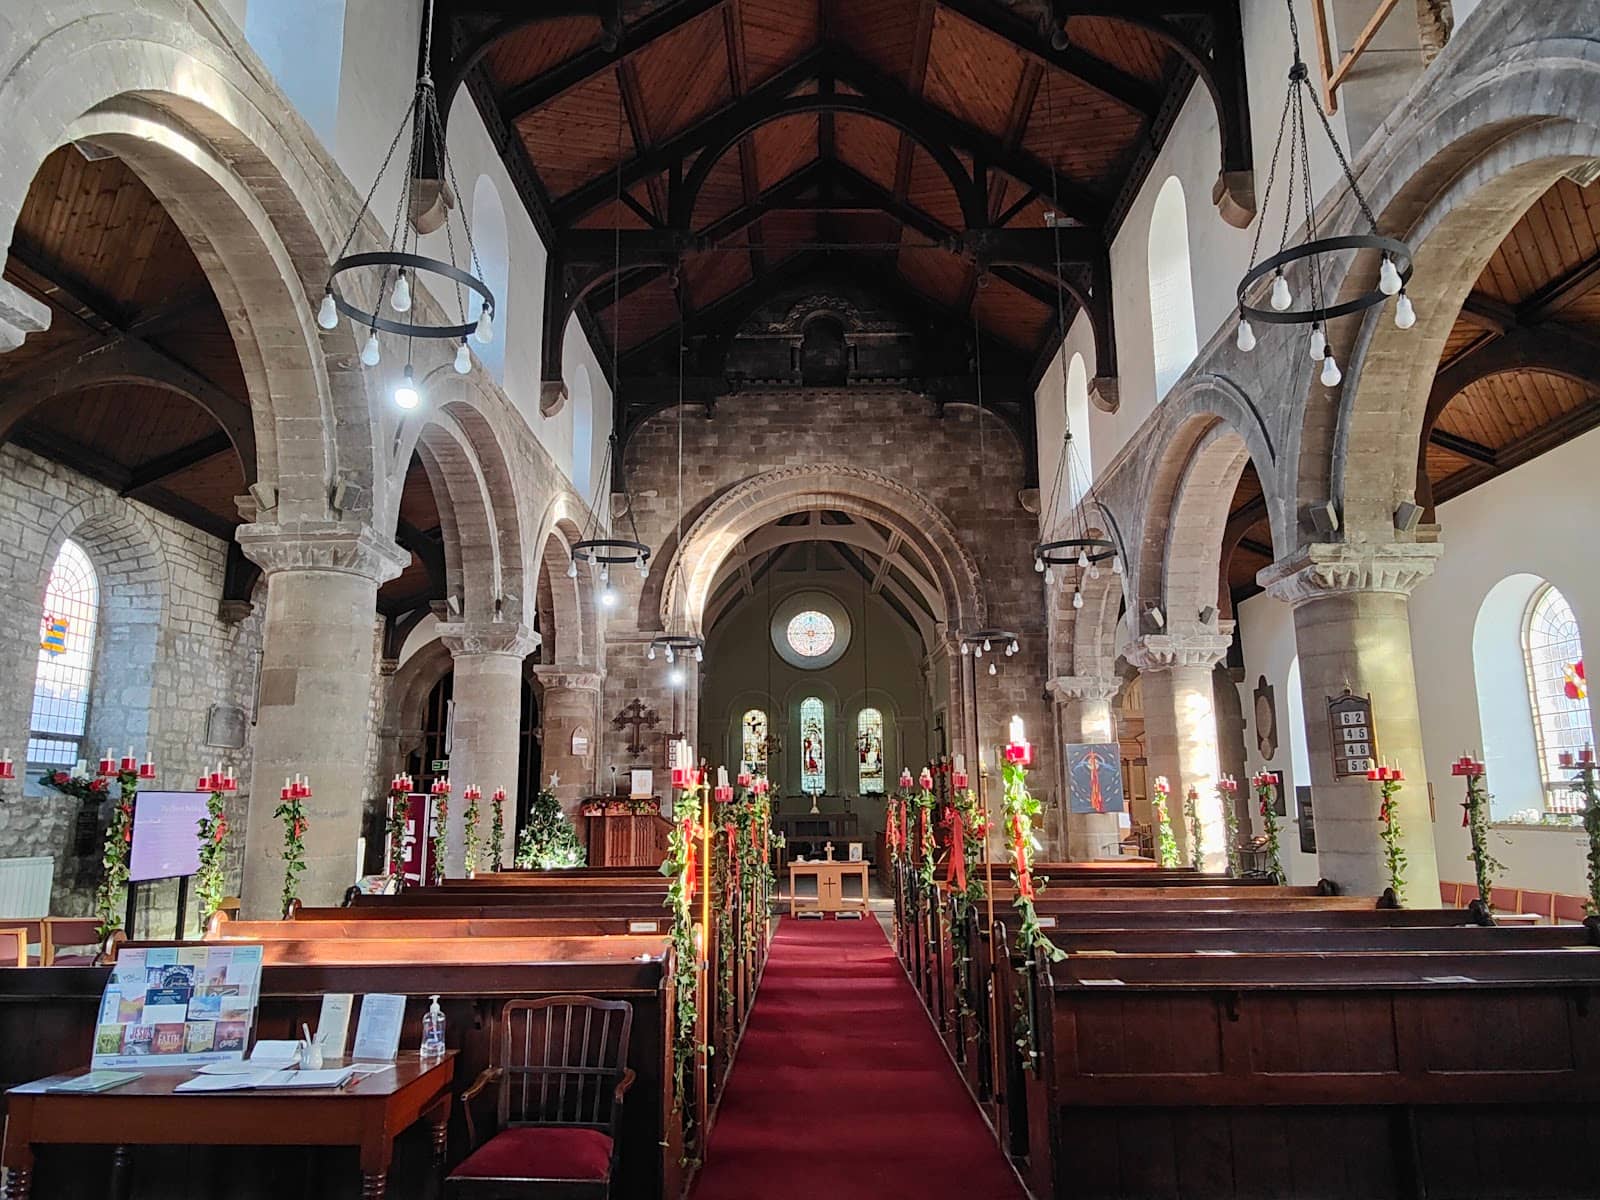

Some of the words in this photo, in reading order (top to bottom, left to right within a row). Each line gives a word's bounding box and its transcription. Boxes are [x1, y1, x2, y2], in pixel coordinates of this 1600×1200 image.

[1344, 713, 1361, 723] 62
[1347, 729, 1364, 739] 45
[1348, 745, 1366, 754] 48
[1351, 761, 1368, 770] 53
[130, 1026, 153, 1039] JESUS
[158, 1033, 180, 1045] FAITH
